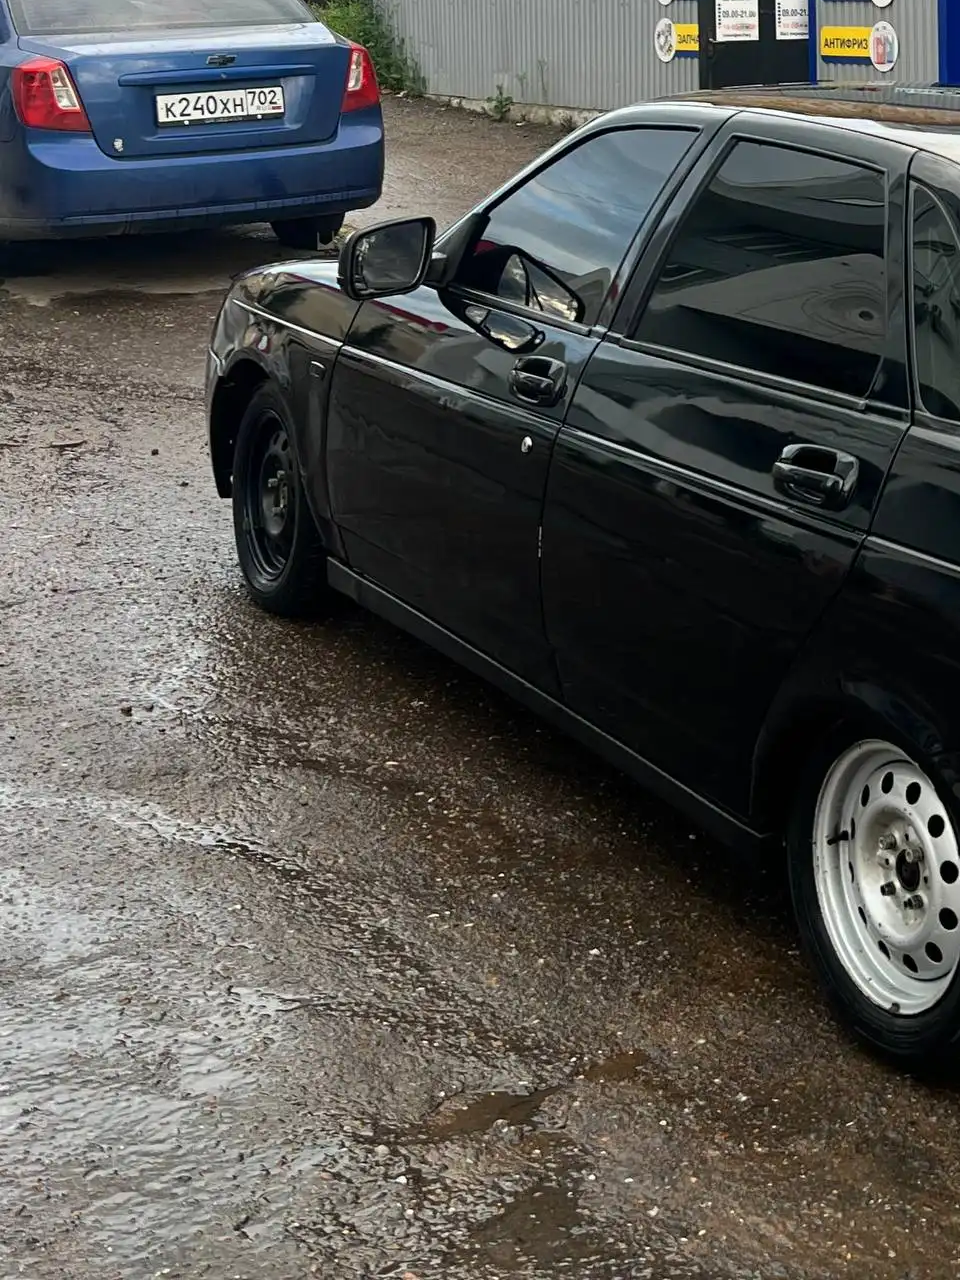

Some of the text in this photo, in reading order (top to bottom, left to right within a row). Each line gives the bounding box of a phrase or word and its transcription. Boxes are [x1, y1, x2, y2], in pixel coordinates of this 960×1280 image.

[824, 37, 868, 49] АНТИФРИЗ
[165, 90, 277, 118] К240ХН 702
